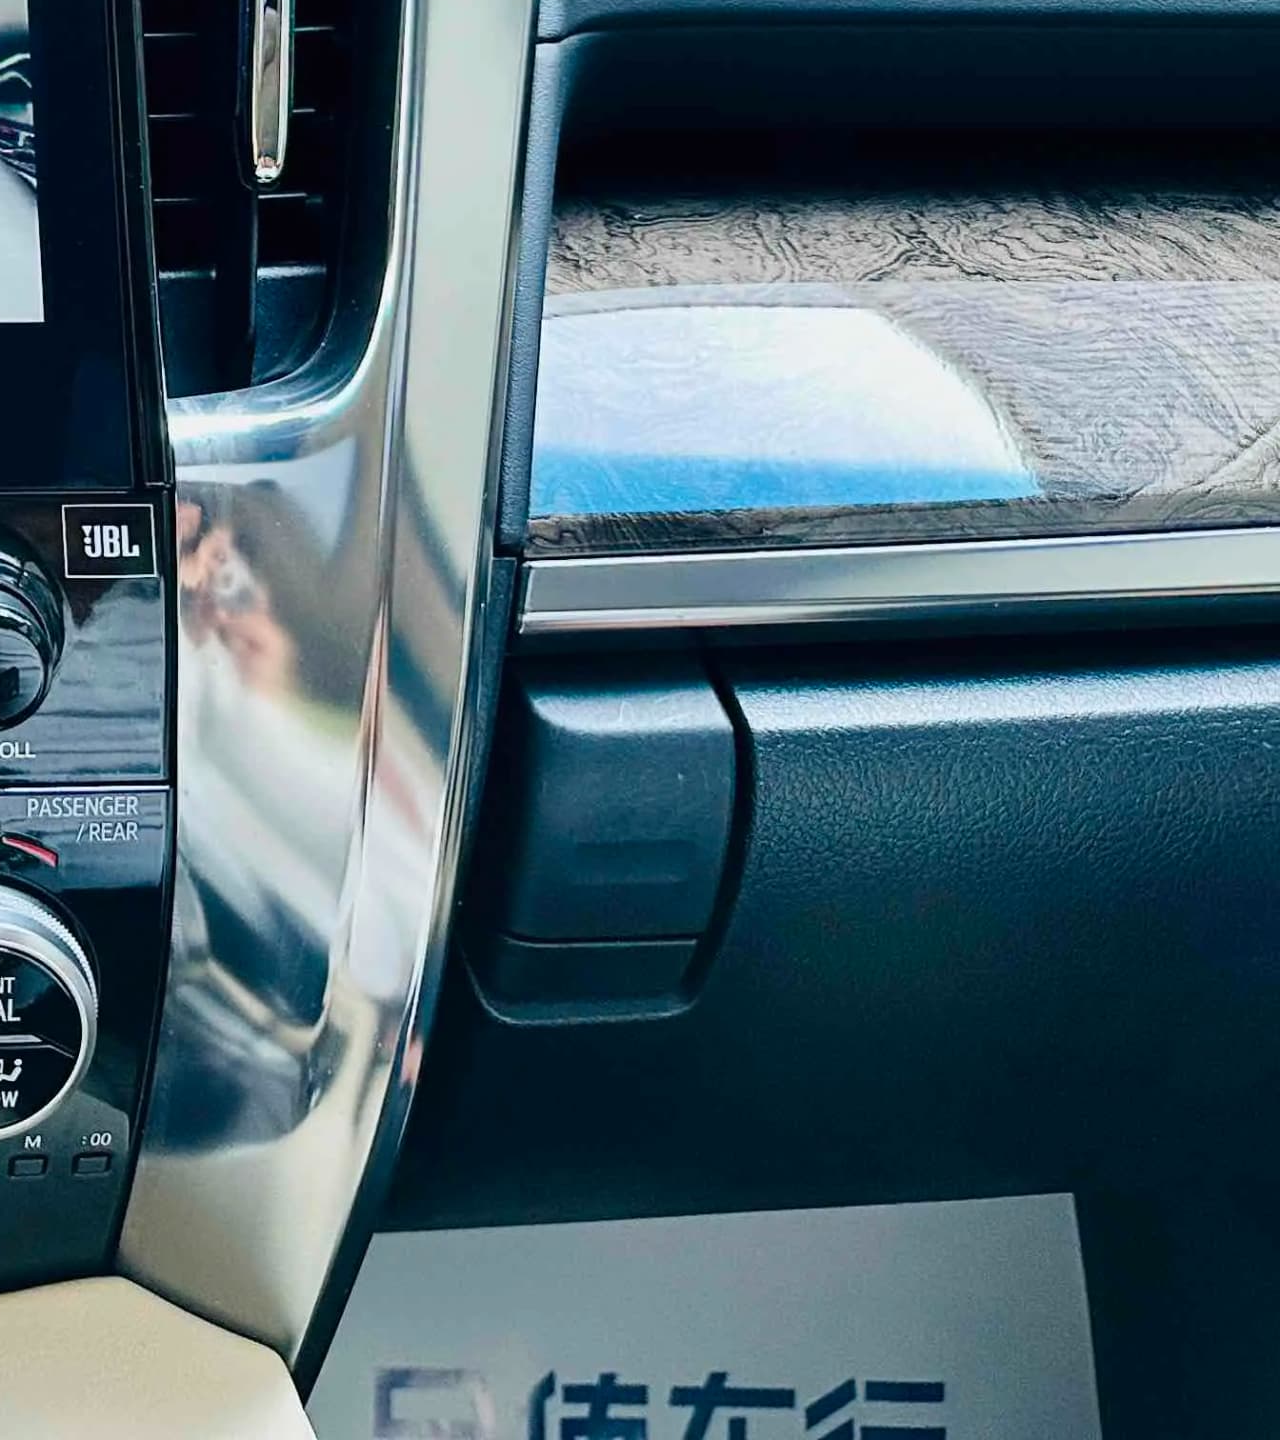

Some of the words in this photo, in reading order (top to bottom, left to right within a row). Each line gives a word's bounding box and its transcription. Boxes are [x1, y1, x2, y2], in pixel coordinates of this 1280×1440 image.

[81, 525, 140, 558] JBL
[27, 795, 139, 818] PASSENGER
[24, 1135, 42, 1149] M
